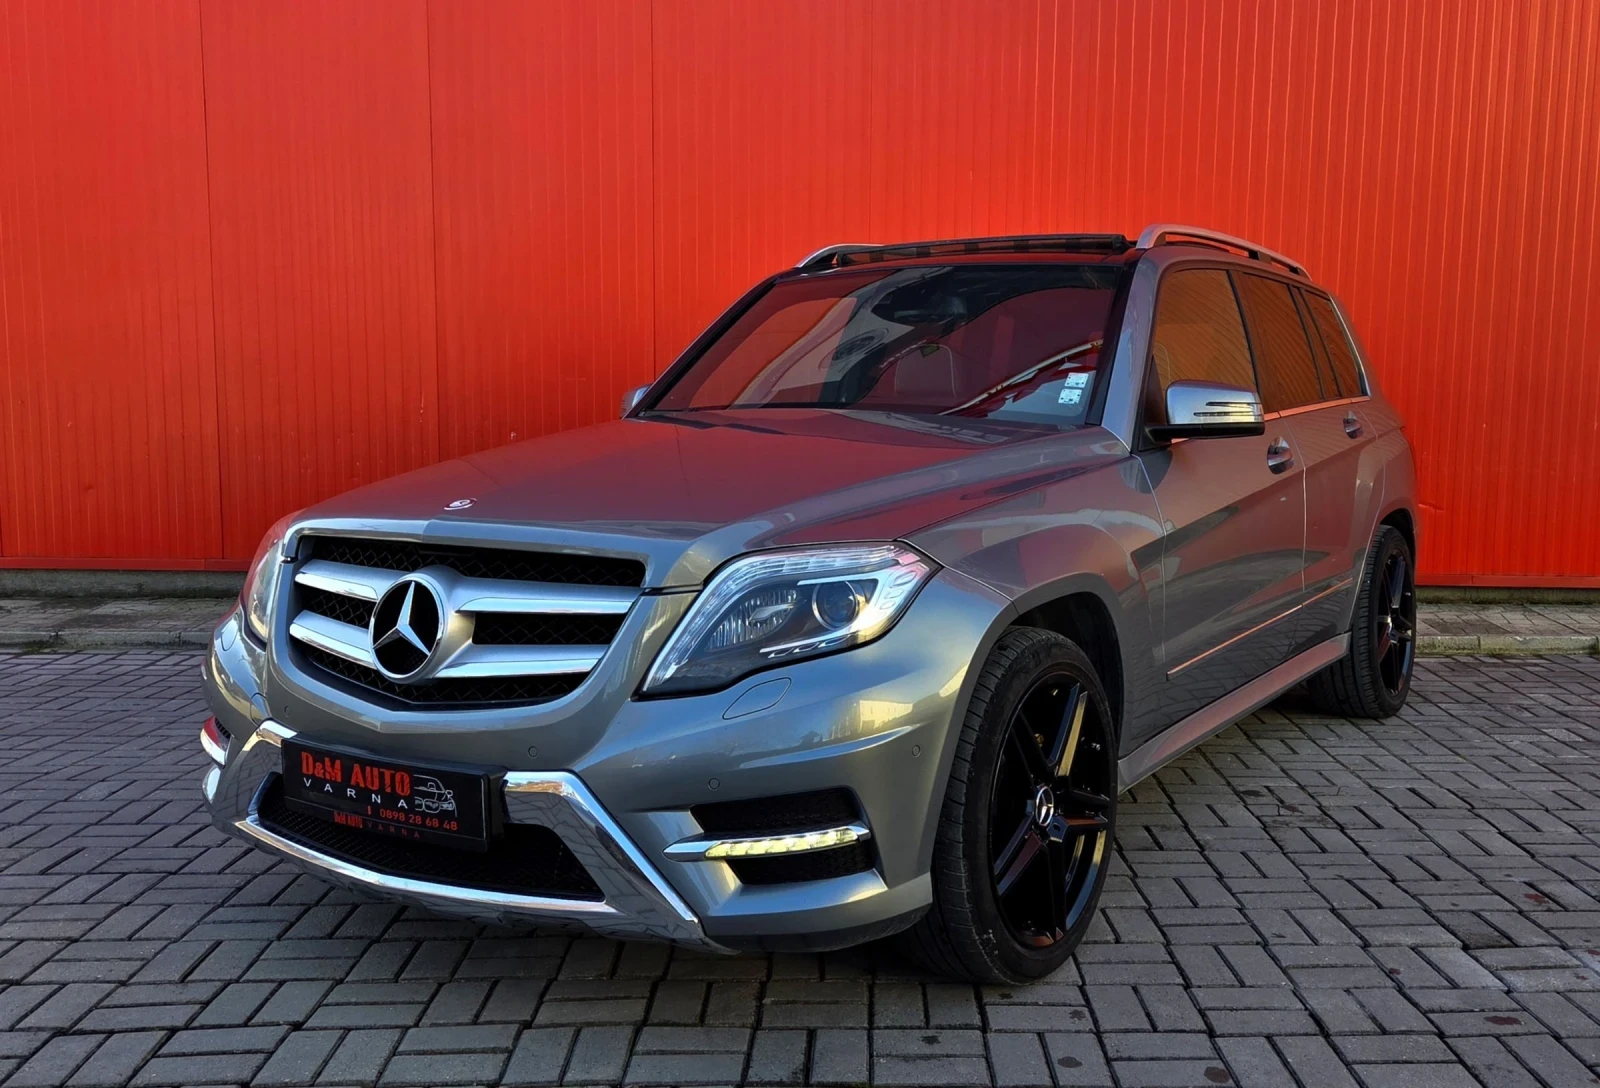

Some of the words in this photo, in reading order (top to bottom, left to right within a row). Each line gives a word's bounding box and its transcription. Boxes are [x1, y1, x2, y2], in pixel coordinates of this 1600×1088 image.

[301, 751, 343, 783] D&M
[350, 763, 411, 796] AUTO
[303, 777, 408, 809] VARNA
[347, 813, 363, 829] AUTO
[380, 808, 406, 822] 0898
[409, 814, 422, 825] 28
[425, 817, 439, 828] 68
[443, 820, 458, 831] 48
